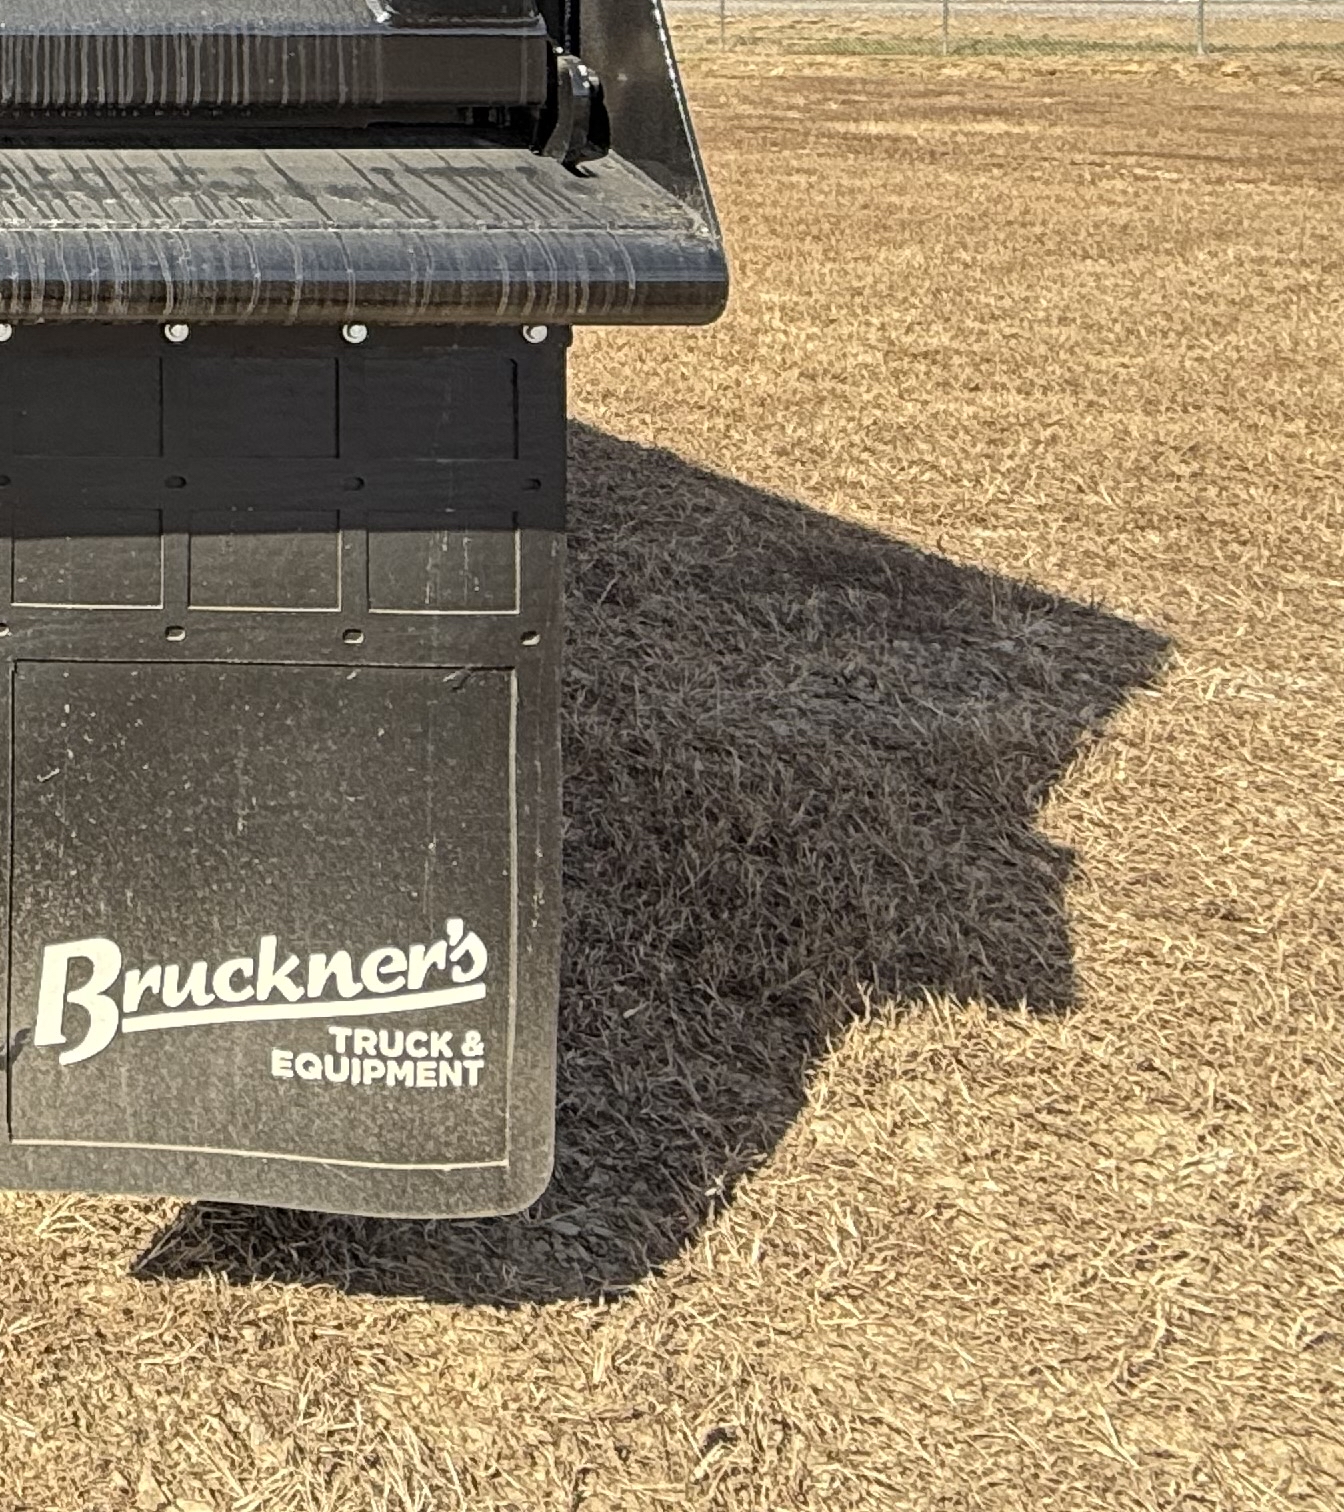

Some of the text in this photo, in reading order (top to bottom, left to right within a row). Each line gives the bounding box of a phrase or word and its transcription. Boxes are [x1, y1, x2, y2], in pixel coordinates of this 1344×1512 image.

[33, 917, 488, 1066] Bruckner's
[327, 1025, 485, 1059] TRUCK &
[270, 1046, 485, 1089] EQUIPMENT
